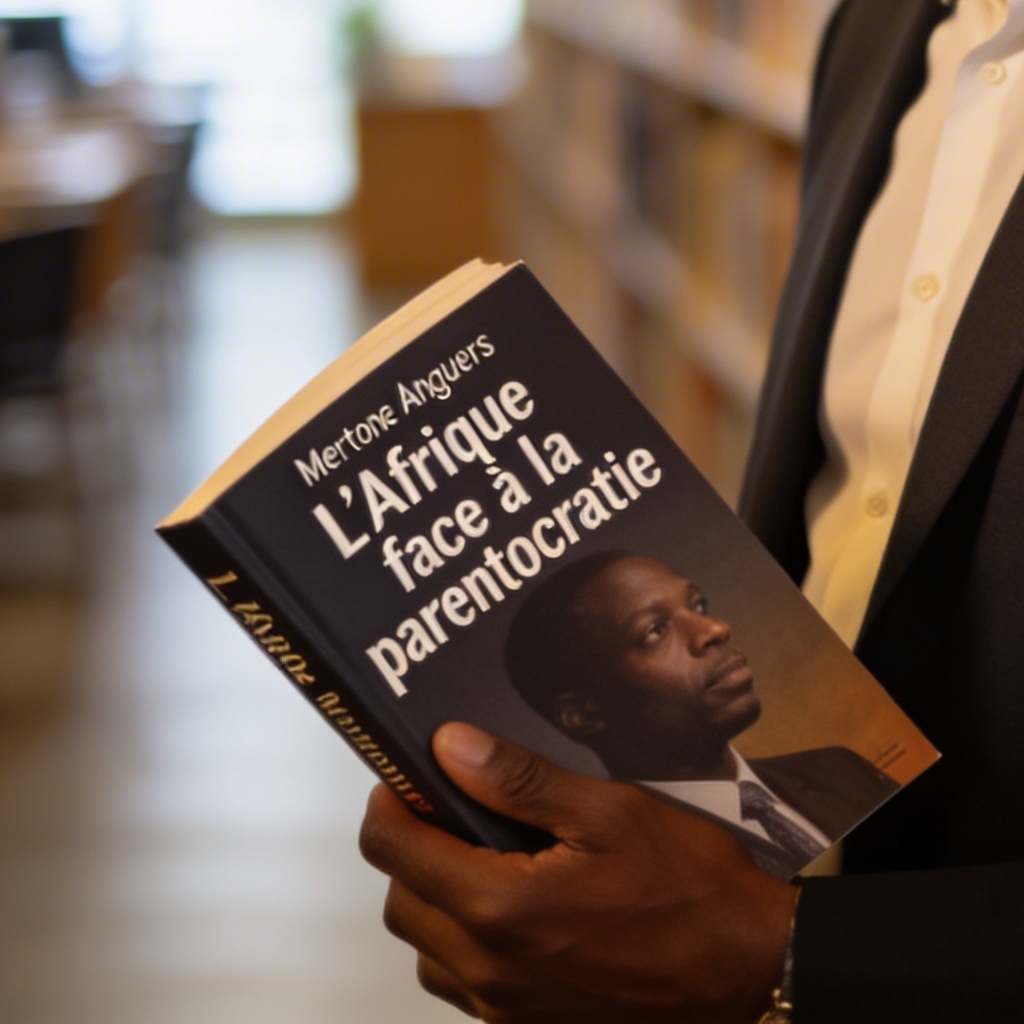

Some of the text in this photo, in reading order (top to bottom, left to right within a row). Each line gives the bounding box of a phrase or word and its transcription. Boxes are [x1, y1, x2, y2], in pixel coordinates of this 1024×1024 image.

[397, 334, 495, 415] Anguers
[312, 381, 534, 560] L'Afrique
[382, 434, 583, 593] face à la
[365, 448, 662, 695] parentocratie
